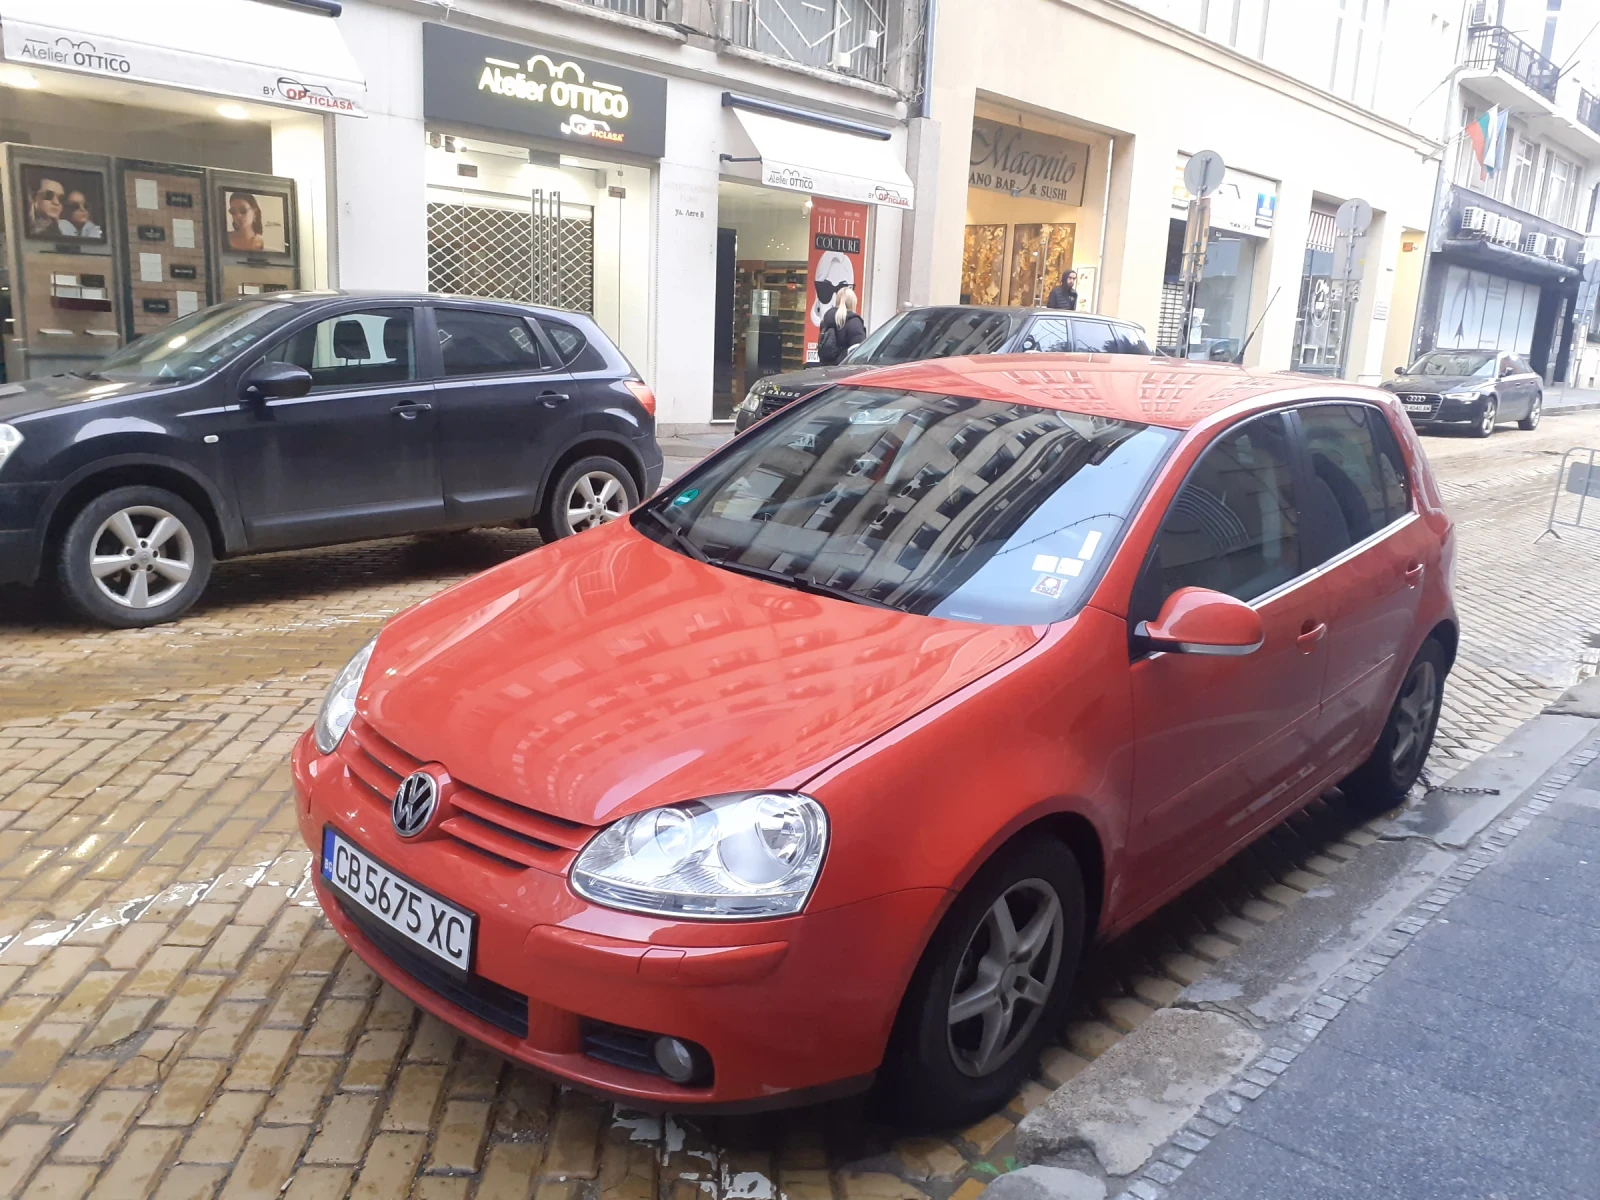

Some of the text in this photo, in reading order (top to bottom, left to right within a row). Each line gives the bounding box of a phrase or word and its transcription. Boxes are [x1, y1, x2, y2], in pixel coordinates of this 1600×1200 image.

[21, 44, 131, 73] Atelier OTTICO
[262, 86, 276, 96] BY
[285, 88, 354, 111] OPTICLASA
[478, 66, 629, 119] Atelier OTTICO
[575, 123, 624, 142] OTICLASA
[970, 127, 1078, 193] Magnito
[768, 174, 814, 190] Atelier OTTICO
[968, 171, 992, 187] ANO
[1029, 183, 1037, 195] &
[1040, 185, 1067, 201] SUSHI
[817, 214, 860, 238] HAUTE
[816, 236, 859, 253] COUTURE
[767, 389, 801, 398] RANGE
[324, 857, 333, 873] BG
